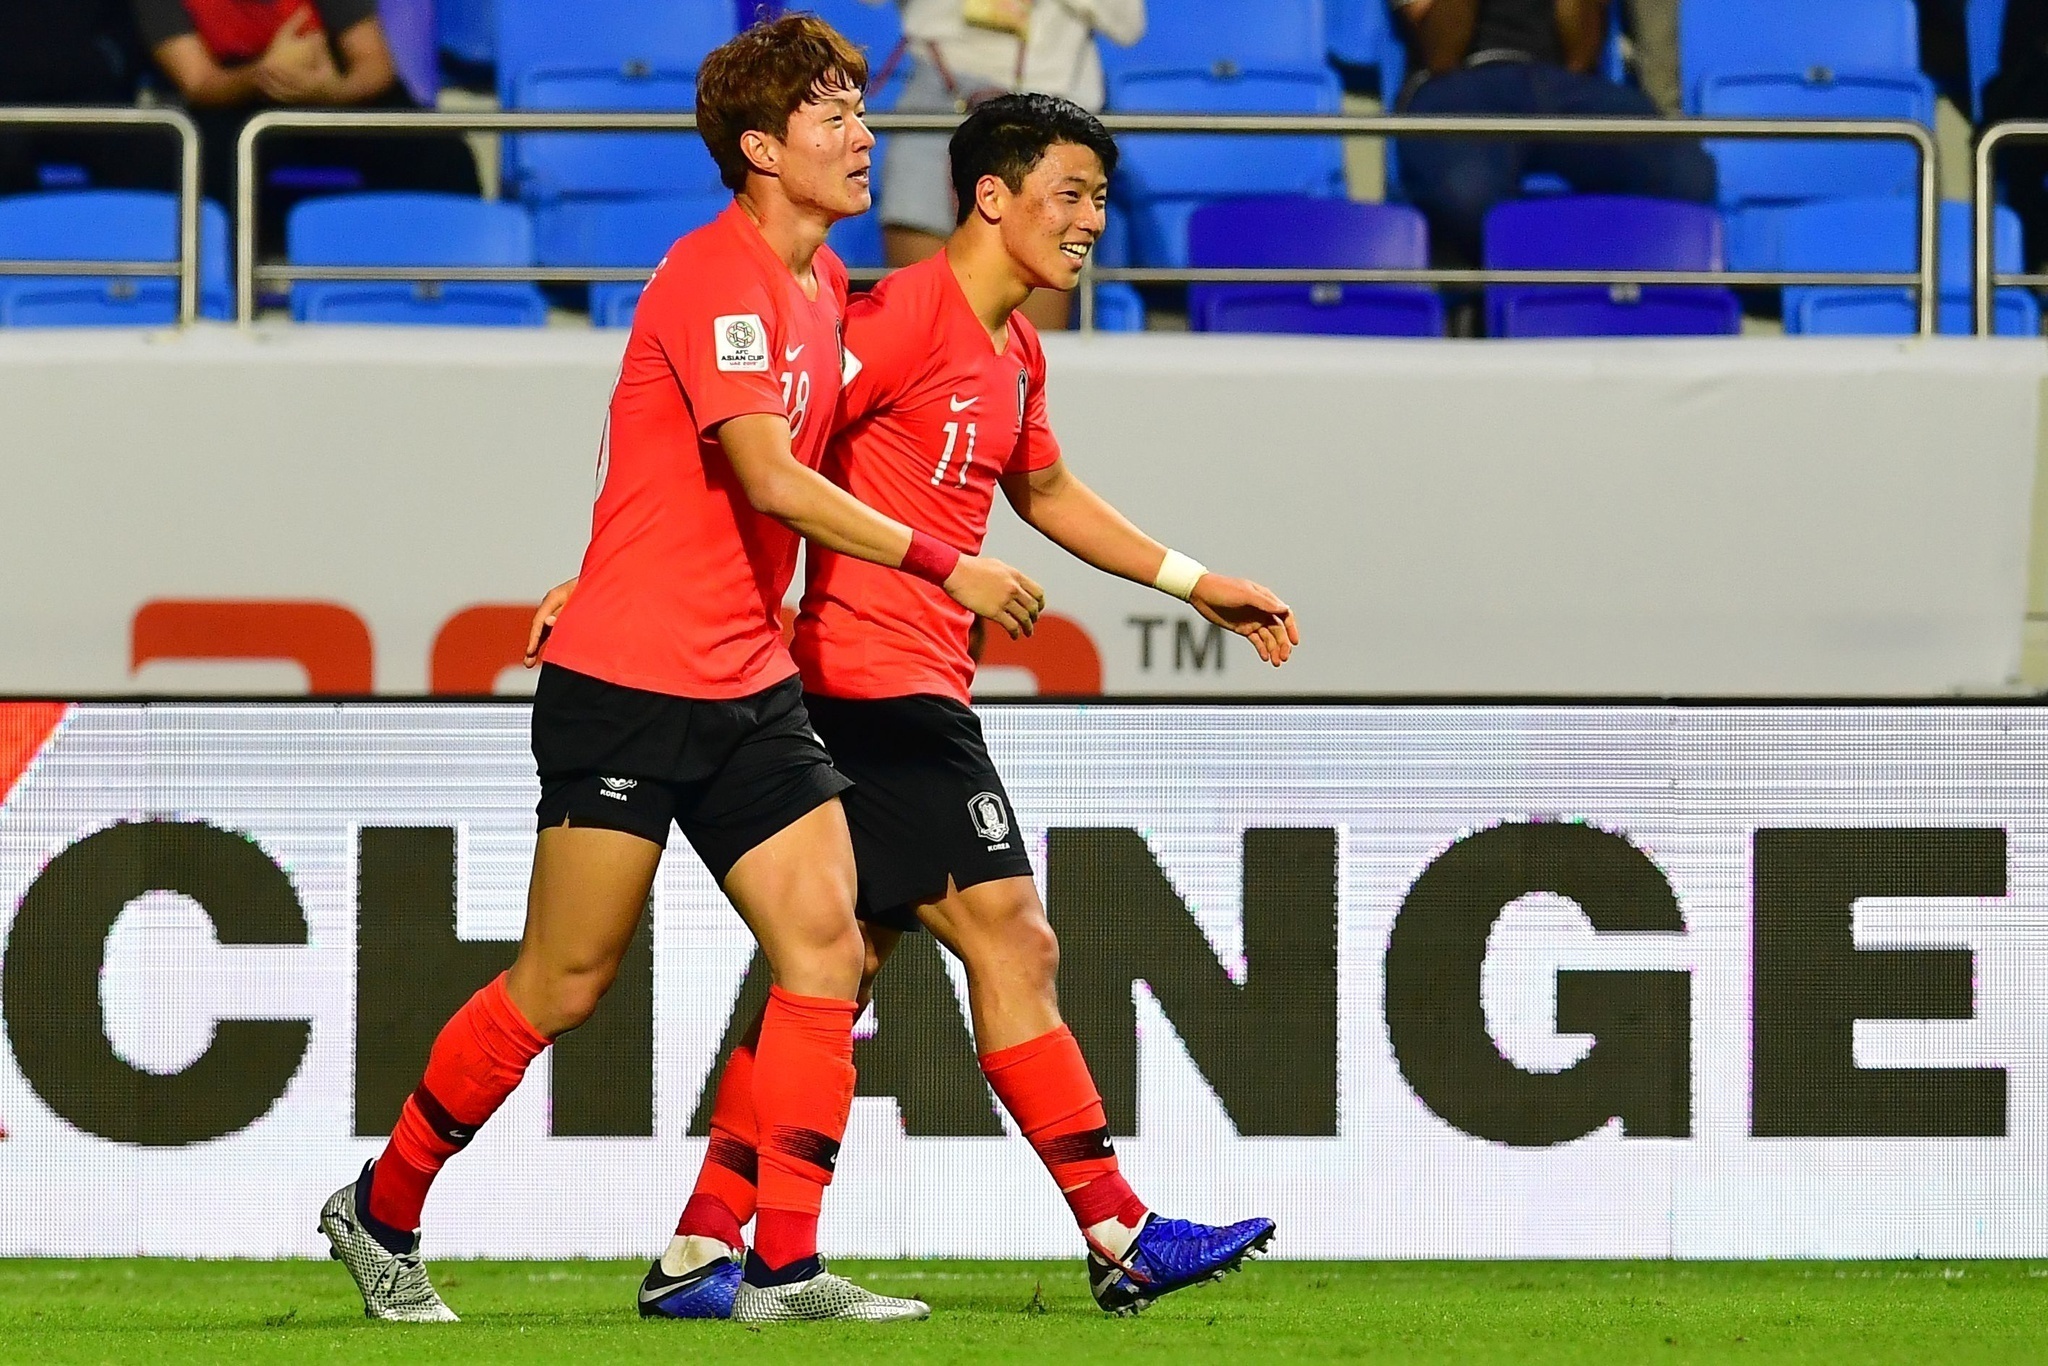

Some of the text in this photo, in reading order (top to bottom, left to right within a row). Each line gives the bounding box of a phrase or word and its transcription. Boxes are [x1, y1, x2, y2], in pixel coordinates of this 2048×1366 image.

[779, 371, 810, 440] 18
[930, 421, 977, 489] 11
[1126, 617, 1225, 671] TM
[600, 789, 627, 802] KOREA
[4, 819, 2009, 1147] CHANGE
